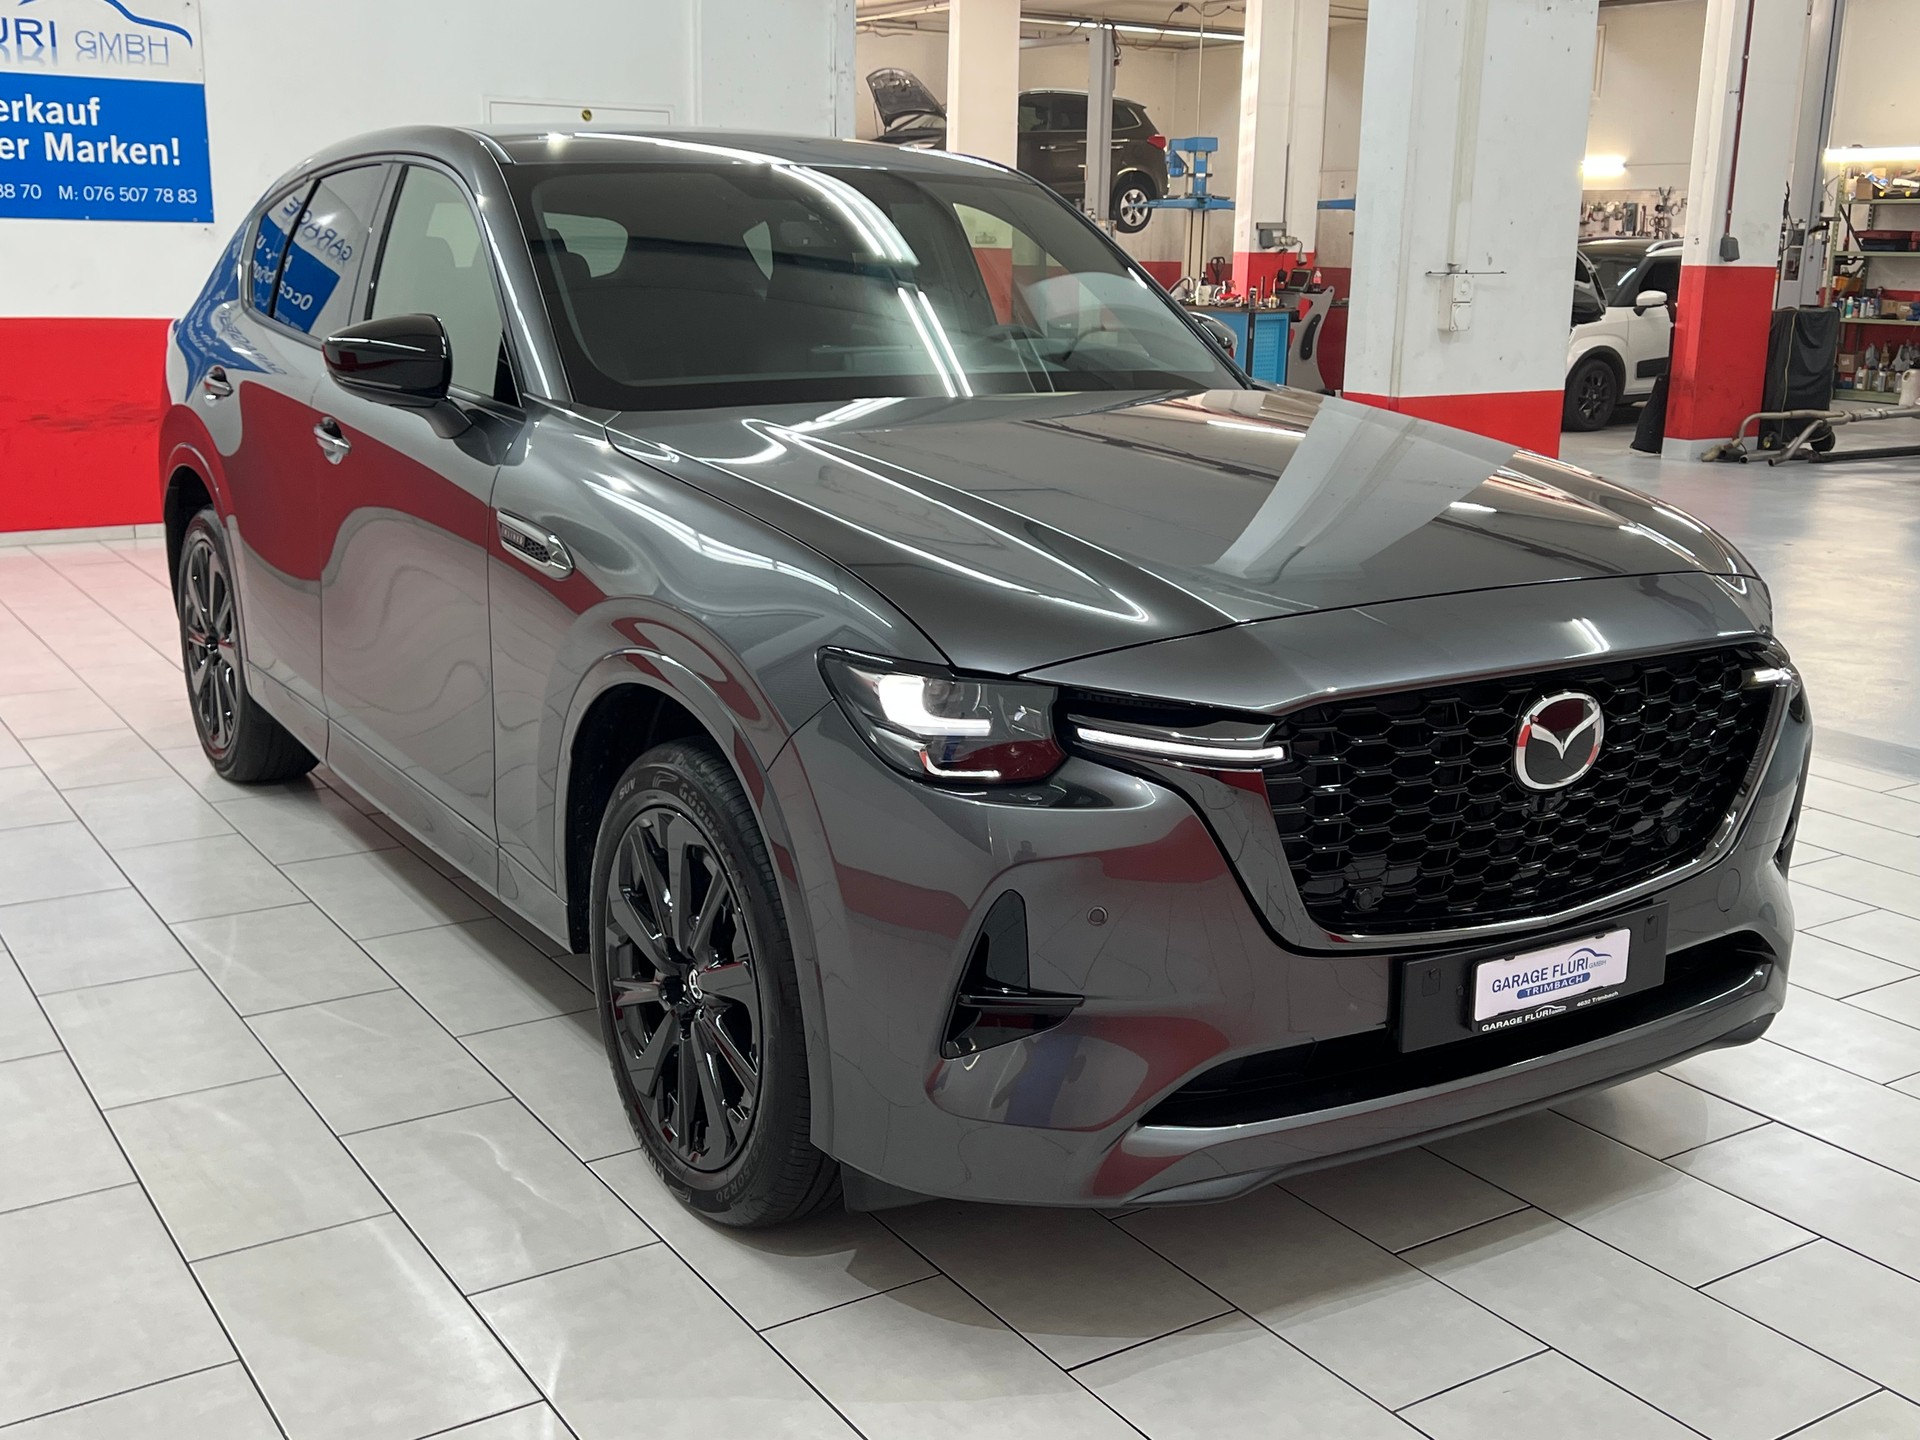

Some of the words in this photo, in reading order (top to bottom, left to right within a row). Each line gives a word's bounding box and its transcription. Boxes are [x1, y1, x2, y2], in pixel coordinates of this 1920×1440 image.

[75, 30, 169, 54] GMBH
[44, 131, 181, 166] Marken!
[20, 184, 42, 199] 70
[58, 185, 79, 200] M:
[83, 186, 115, 201] 076
[119, 187, 149, 202] 507
[153, 188, 174, 203] 78
[177, 189, 198, 204] 83
[618, 777, 636, 800] SUV
[1491, 967, 1549, 993] GARAGE
[1552, 957, 1589, 978] FLURI
[1525, 974, 1584, 997] TRIMBACH
[1592, 991, 1619, 1003] Trimbach
[1481, 1016, 1523, 1032] GARAGE
[1525, 1008, 1552, 1022] FLURI
